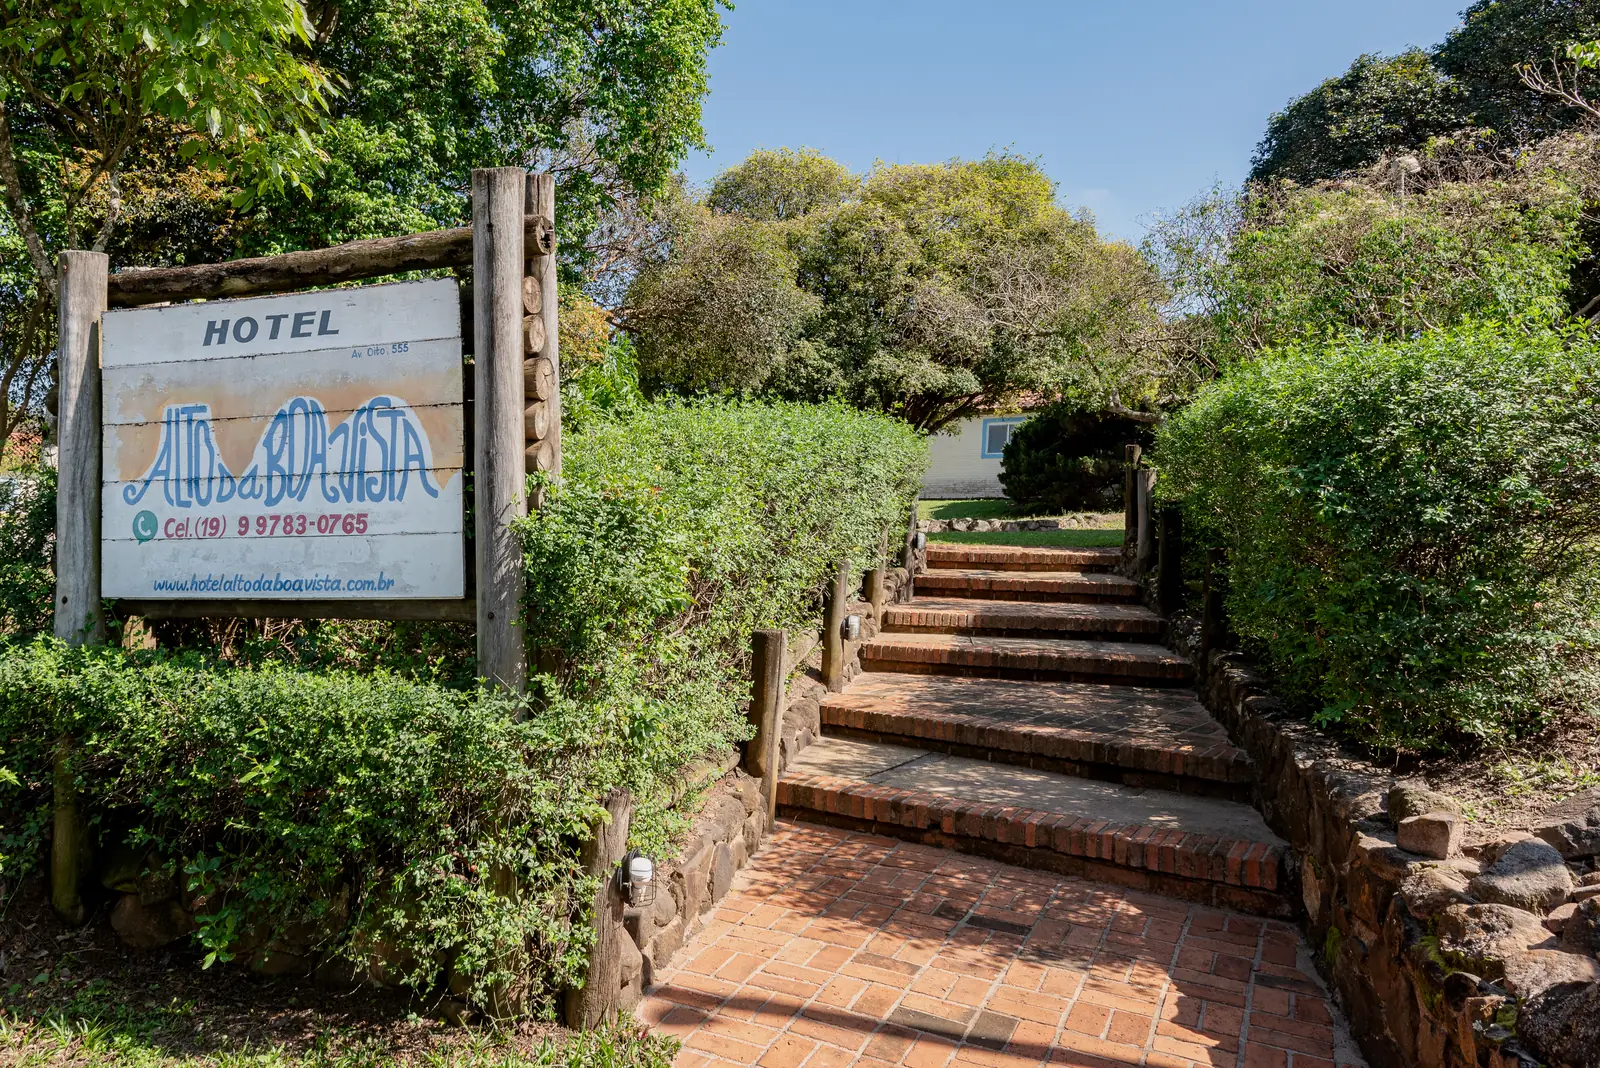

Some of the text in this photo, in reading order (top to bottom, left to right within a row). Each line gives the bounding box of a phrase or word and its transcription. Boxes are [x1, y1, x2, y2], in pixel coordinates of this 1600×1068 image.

[202, 309, 340, 347] HOTEL
[391, 343, 409, 354] 555
[122, 405, 215, 509] ALTO
[262, 397, 340, 507] BOA
[255, 512, 369, 536] 9783-0765
[153, 570, 396, 593] www.hotelaltodaboavista.com.br
